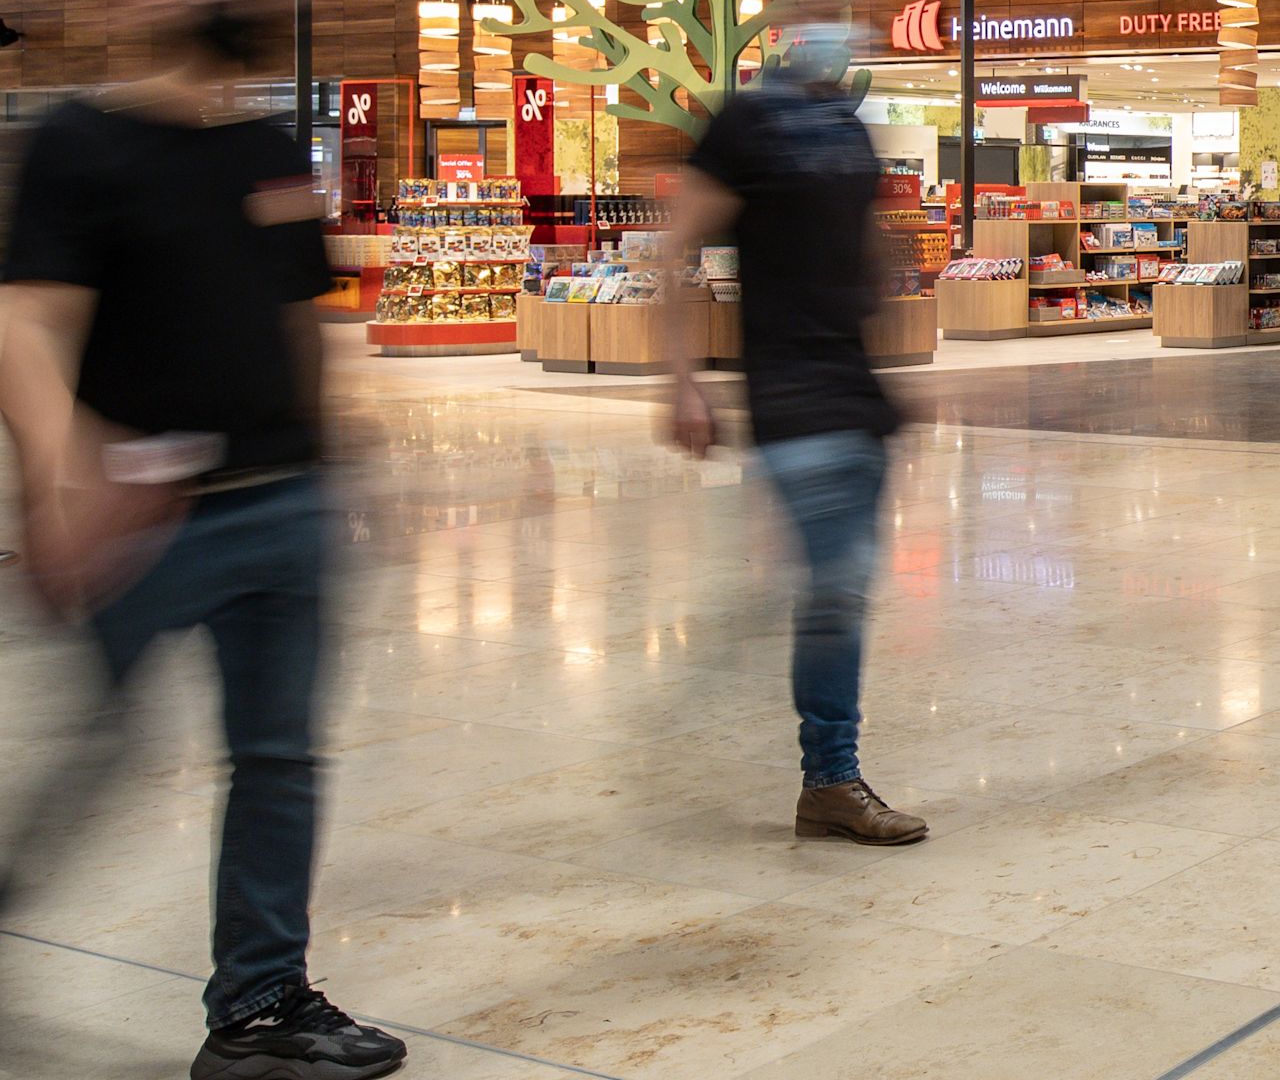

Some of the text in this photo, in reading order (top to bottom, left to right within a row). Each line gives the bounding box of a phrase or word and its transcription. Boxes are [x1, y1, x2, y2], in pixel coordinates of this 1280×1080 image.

[1119, 14, 1172, 34] DUTY
[981, 82, 1073, 94] Welcome Willkommen
[892, 183, 913, 194] 30%
